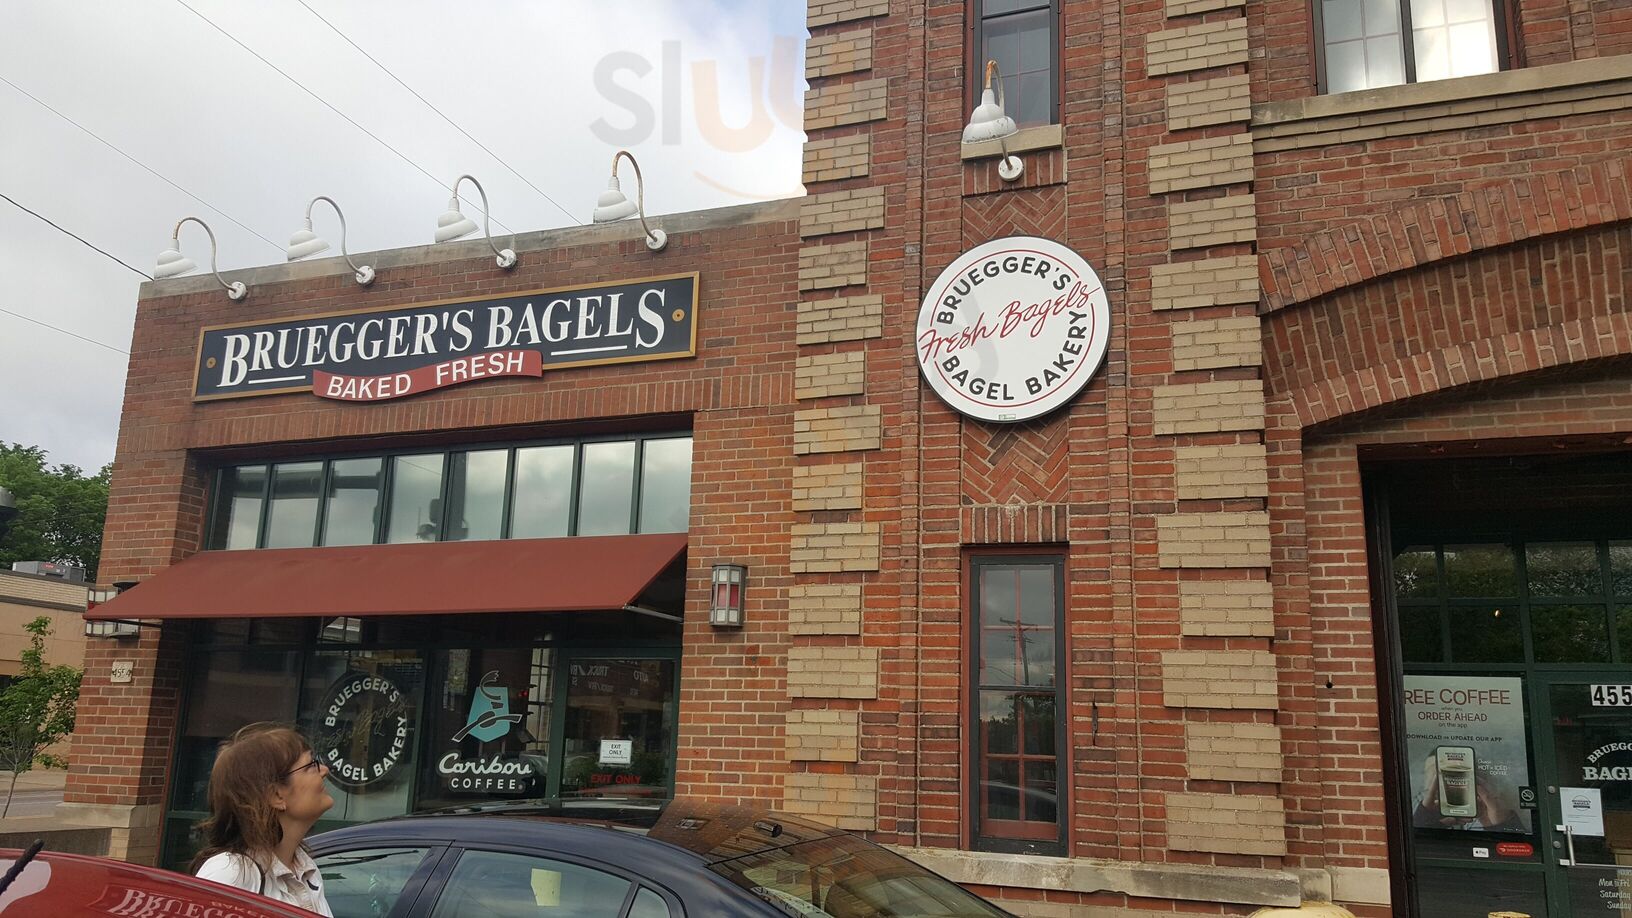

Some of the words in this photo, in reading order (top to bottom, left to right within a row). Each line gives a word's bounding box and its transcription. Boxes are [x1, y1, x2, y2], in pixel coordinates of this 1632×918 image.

[937, 256, 1071, 325] BRUEGGER'S
[216, 309, 474, 388] BRUEGGER'S
[487, 287, 667, 348] BAGELS
[918, 312, 999, 364] Fresh
[998, 280, 1101, 338] Bagels
[326, 373, 412, 400] BAKED
[436, 351, 524, 384] FRESH
[941, 355, 1015, 401] BAGEL
[1024, 310, 1088, 396] BAKERY
[325, 677, 400, 728] BRUEGGER'S
[1418, 711, 1451, 721] ORDER
[1454, 712, 1488, 722] AHEAD
[1439, 688, 1512, 706] COFFEE
[327, 747, 369, 781] BAGEL
[372, 716, 407, 777] BAKERY
[438, 752, 533, 775] Caribou
[451, 777, 517, 790] COFFEE
[591, 773, 612, 784] EXIT
[615, 774, 641, 785] ONLY
[1600, 889, 1631, 901] Saturday
